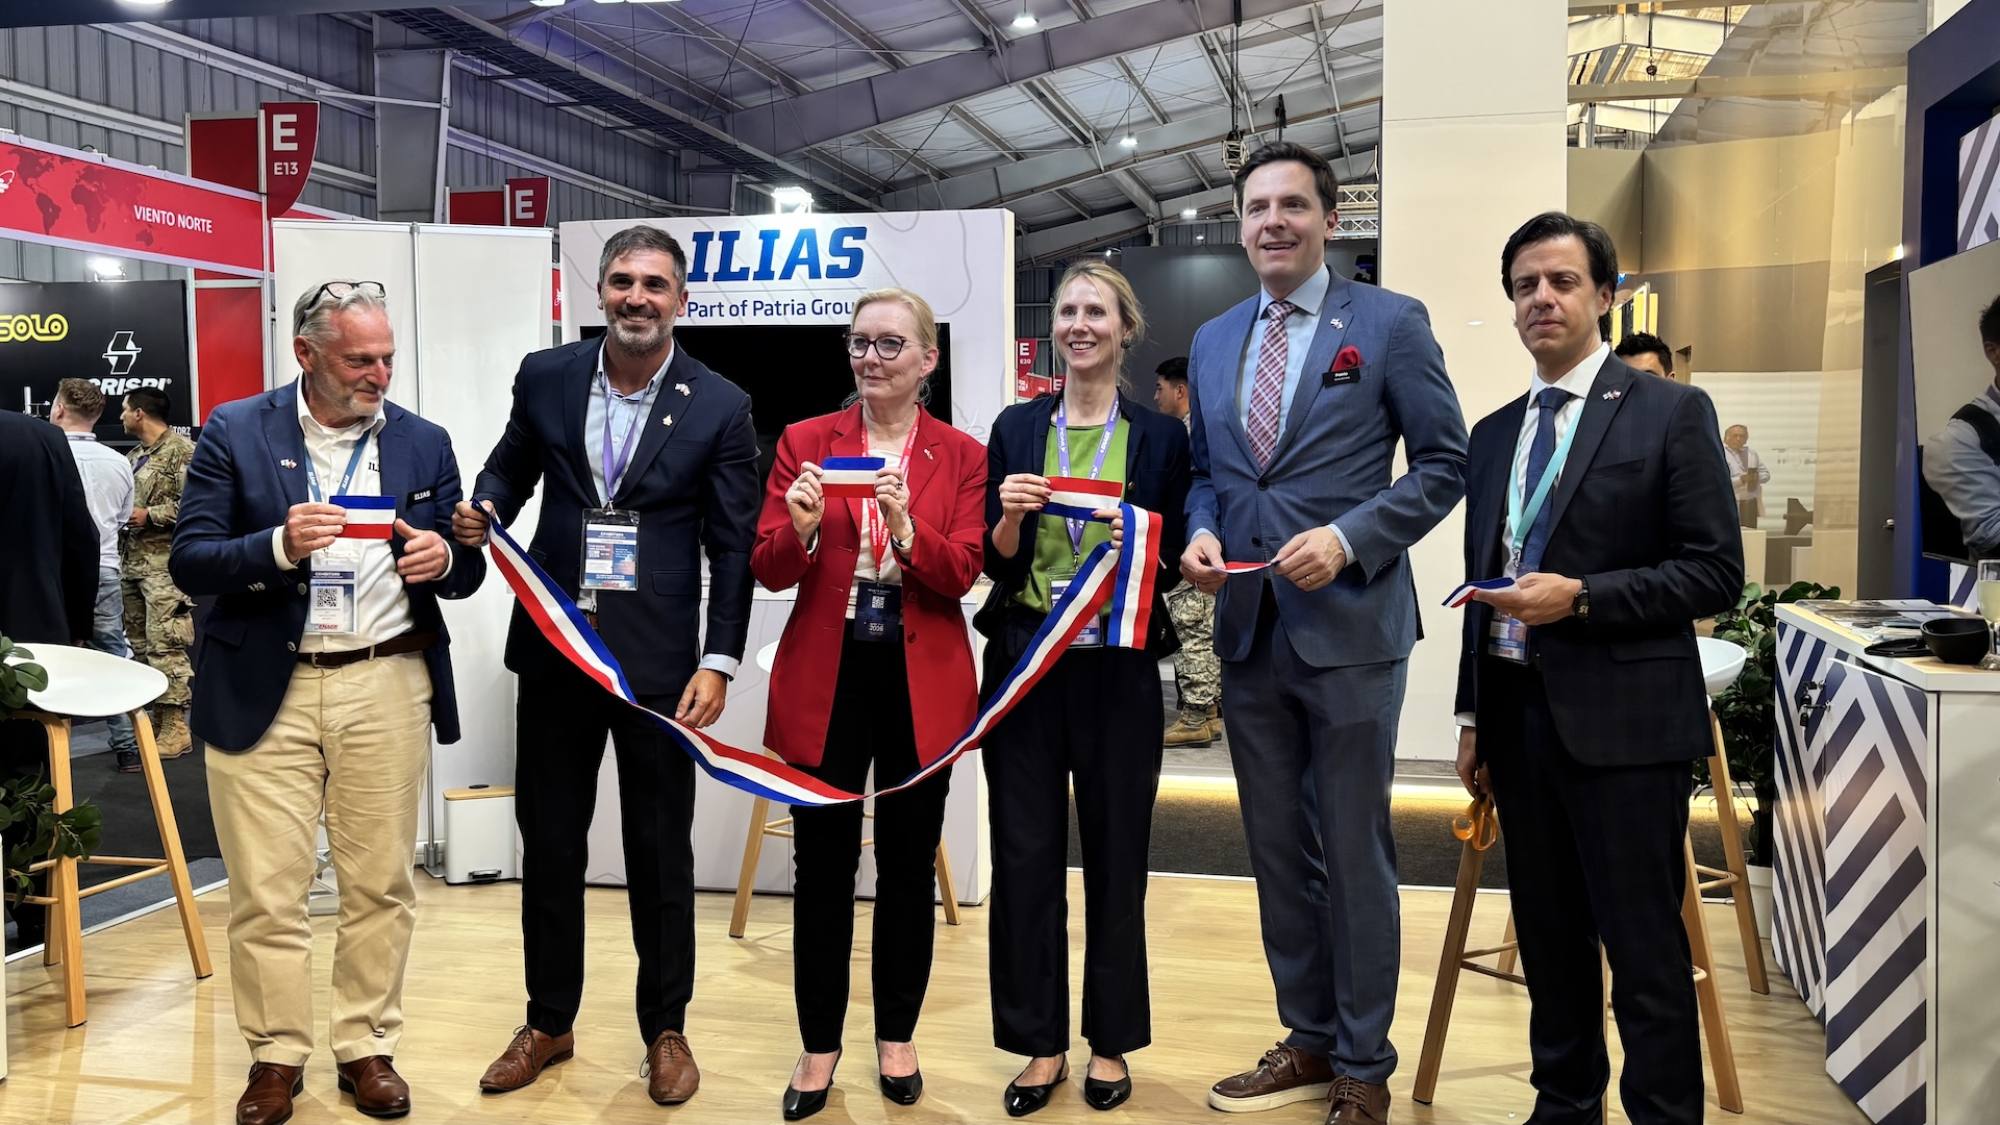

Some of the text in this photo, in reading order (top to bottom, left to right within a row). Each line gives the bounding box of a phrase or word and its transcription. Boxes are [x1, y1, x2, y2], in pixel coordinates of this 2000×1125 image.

[273, 114, 298, 151] E
[274, 162, 298, 175] E13
[516, 190, 534, 219] E
[134, 205, 212, 233] VIENTO NORTE
[688, 227, 867, 282] ILIAS
[688, 299, 854, 317] Part of Patria Grou
[1020, 343, 1029, 356] E
[1053, 379, 1062, 391] E
